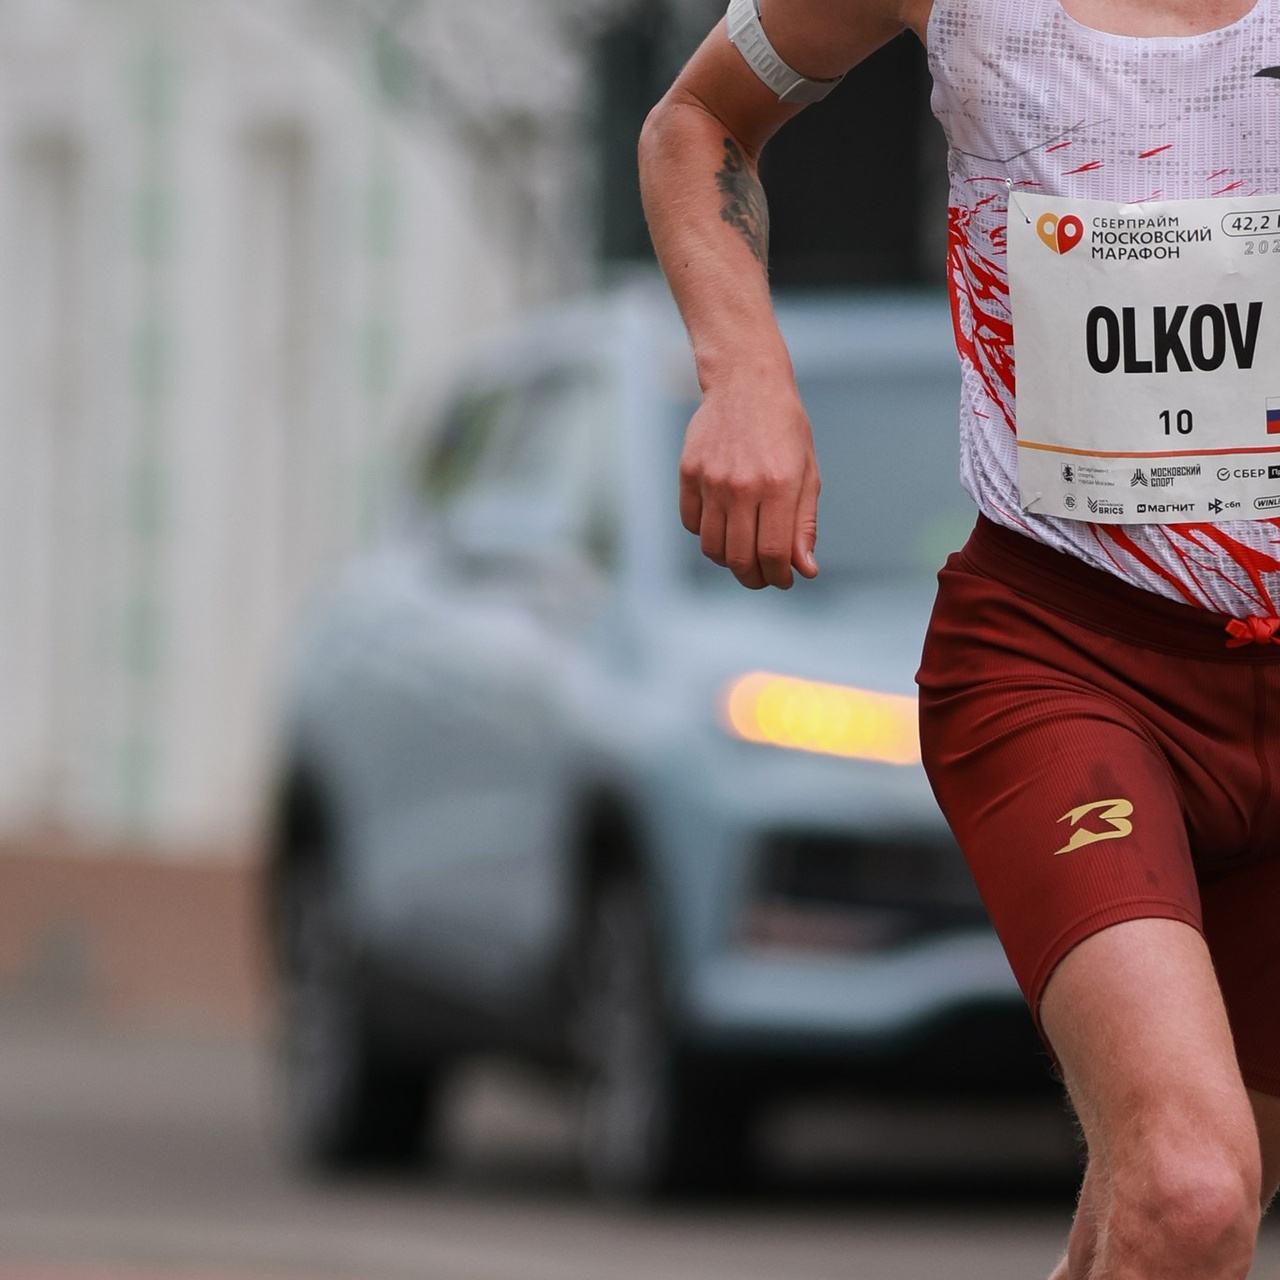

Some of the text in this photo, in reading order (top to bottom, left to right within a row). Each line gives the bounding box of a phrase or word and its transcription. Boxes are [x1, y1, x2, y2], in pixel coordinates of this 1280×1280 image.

[1092, 216, 1179, 229] СБЕРПРАЙМ
[1231, 216, 1270, 232] 42,2
[1091, 226, 1212, 245] МОСКОВСКИЙ
[1091, 246, 1180, 260] МАРАФОН
[1086, 301, 1263, 374] OLKOV
[1159, 409, 1193, 435] 10
[1150, 464, 1201, 477] МОСКОВСКИЙ
[1233, 469, 1266, 478] СБЕР
[1150, 477, 1175, 487] СПОРТ
[1098, 507, 1124, 515] BRICS
